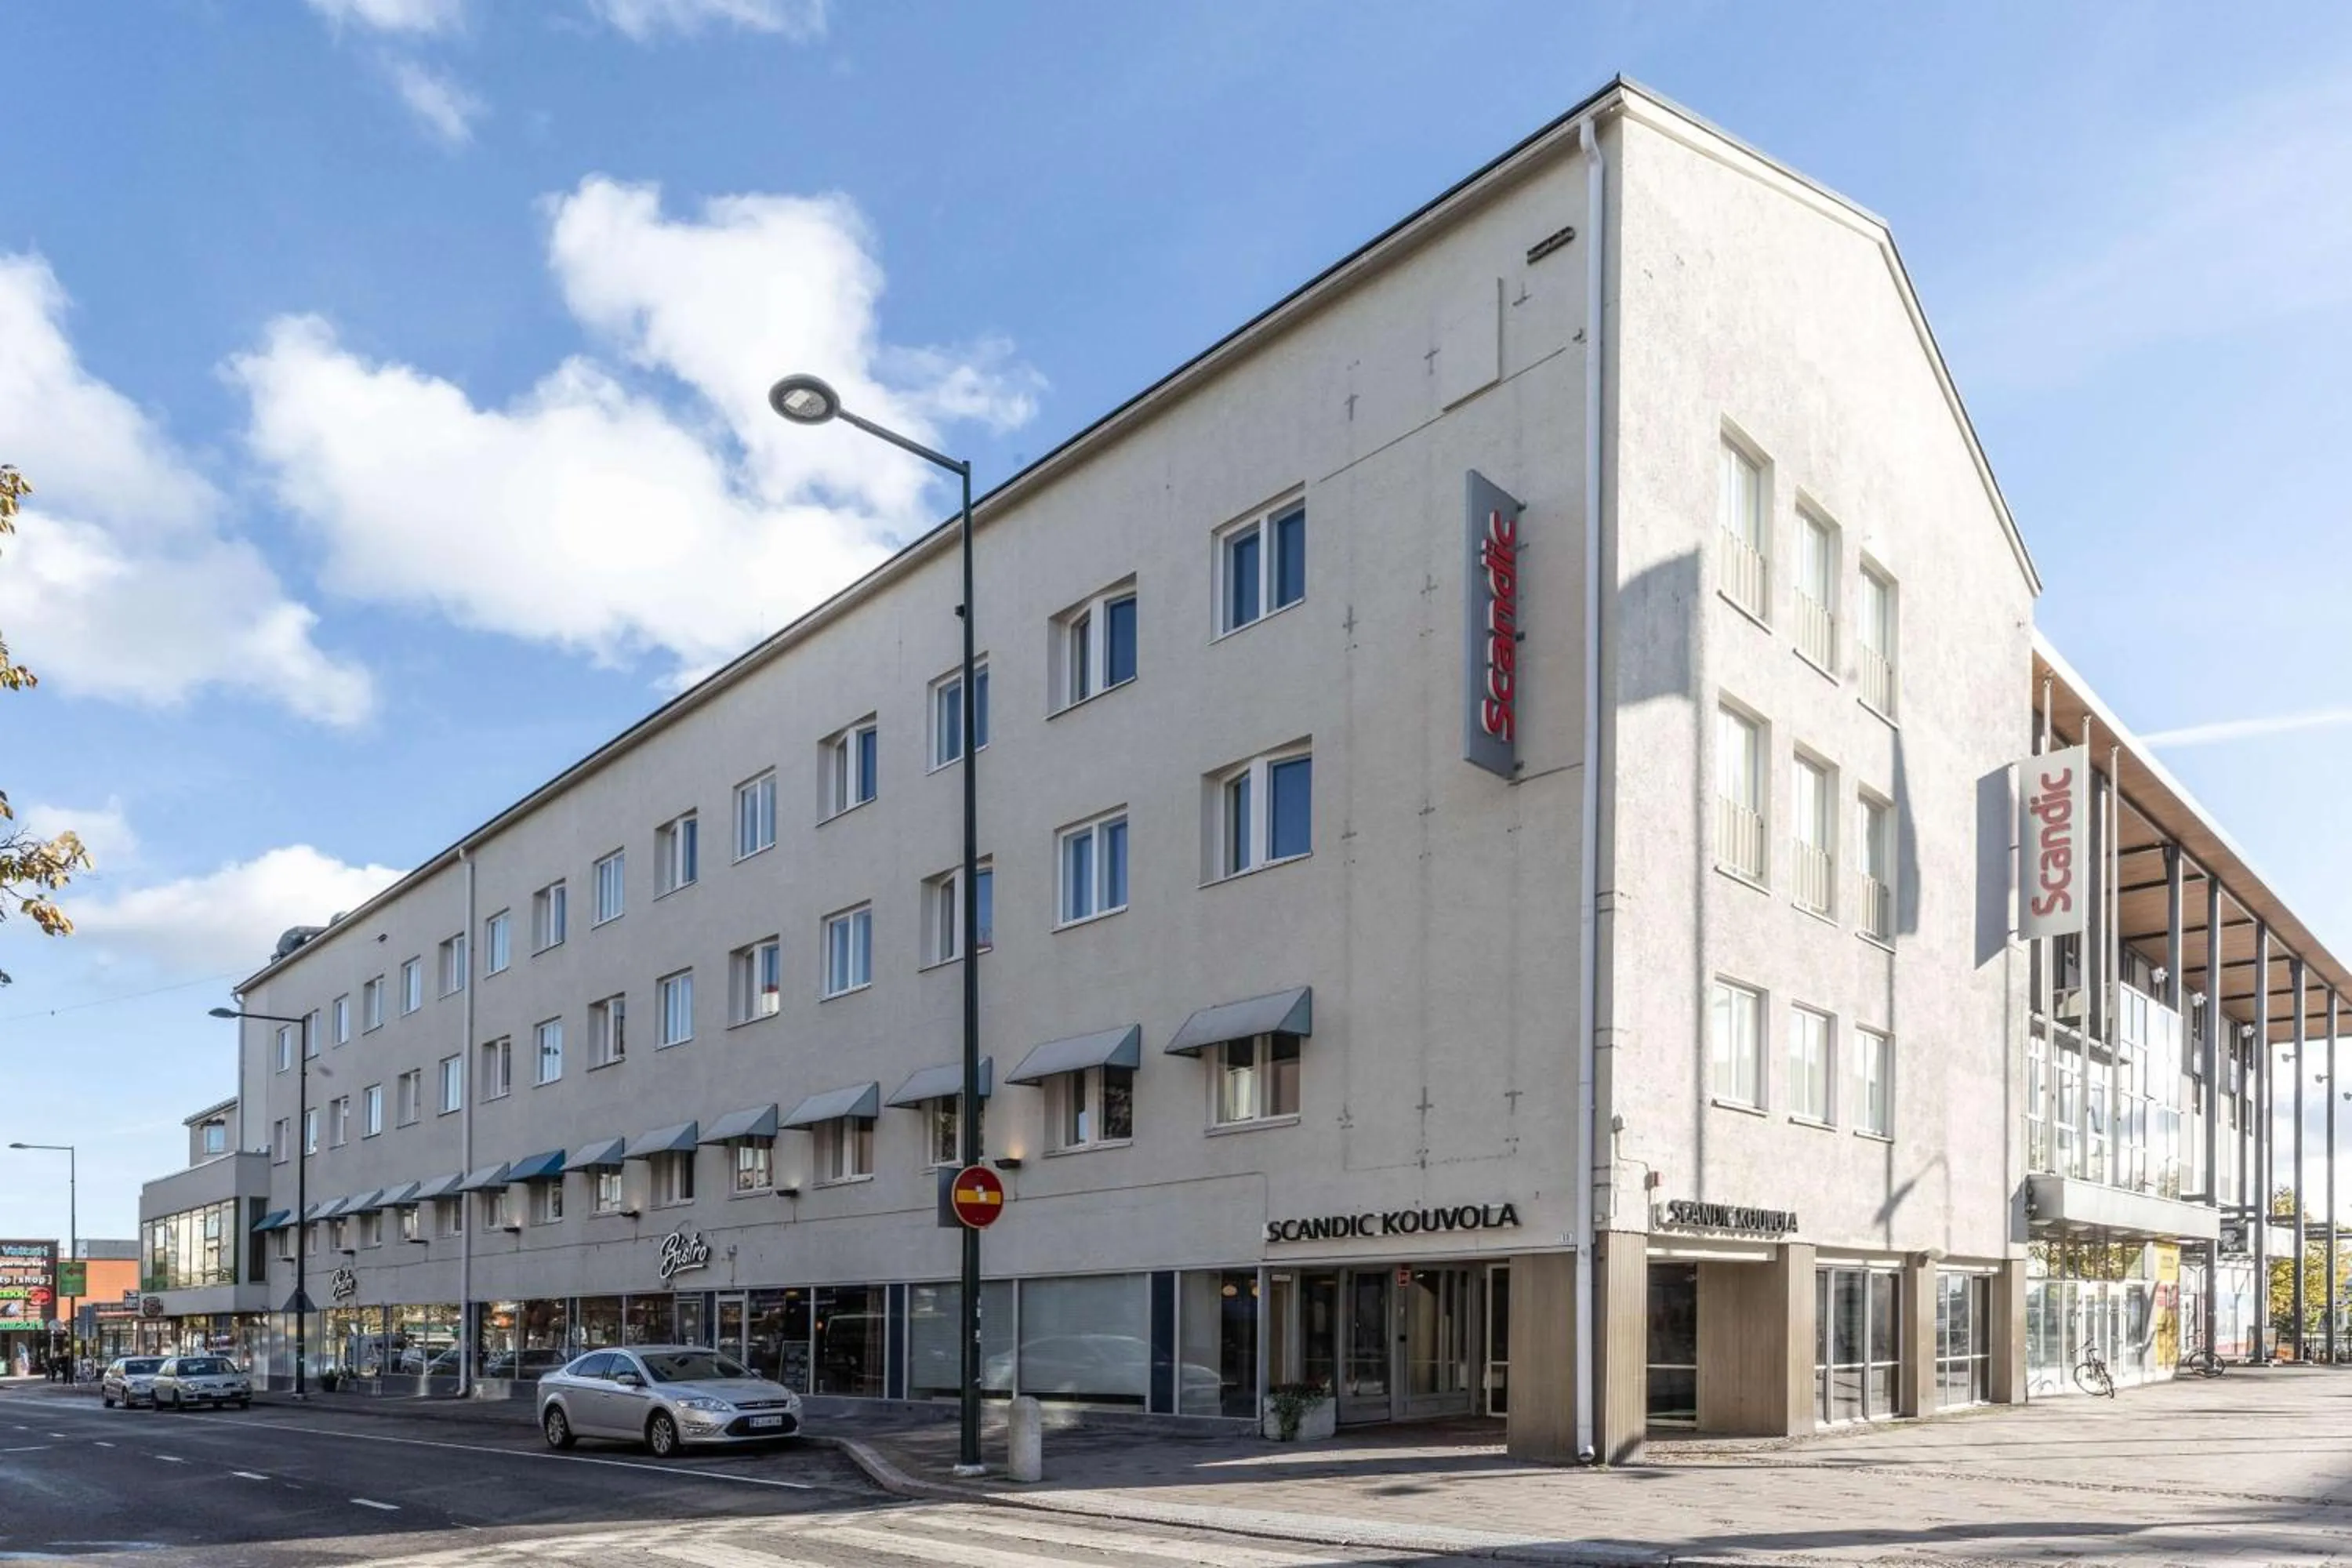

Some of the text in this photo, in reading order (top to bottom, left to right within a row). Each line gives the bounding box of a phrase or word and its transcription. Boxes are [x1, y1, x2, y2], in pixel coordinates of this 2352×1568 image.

[1481, 510, 1516, 741] Scandic
[2031, 768, 2072, 916] Scandic
[660, 1232, 707, 1279] Bistro
[1267, 1203, 1519, 1242] SCANDIC KOUVOLA
